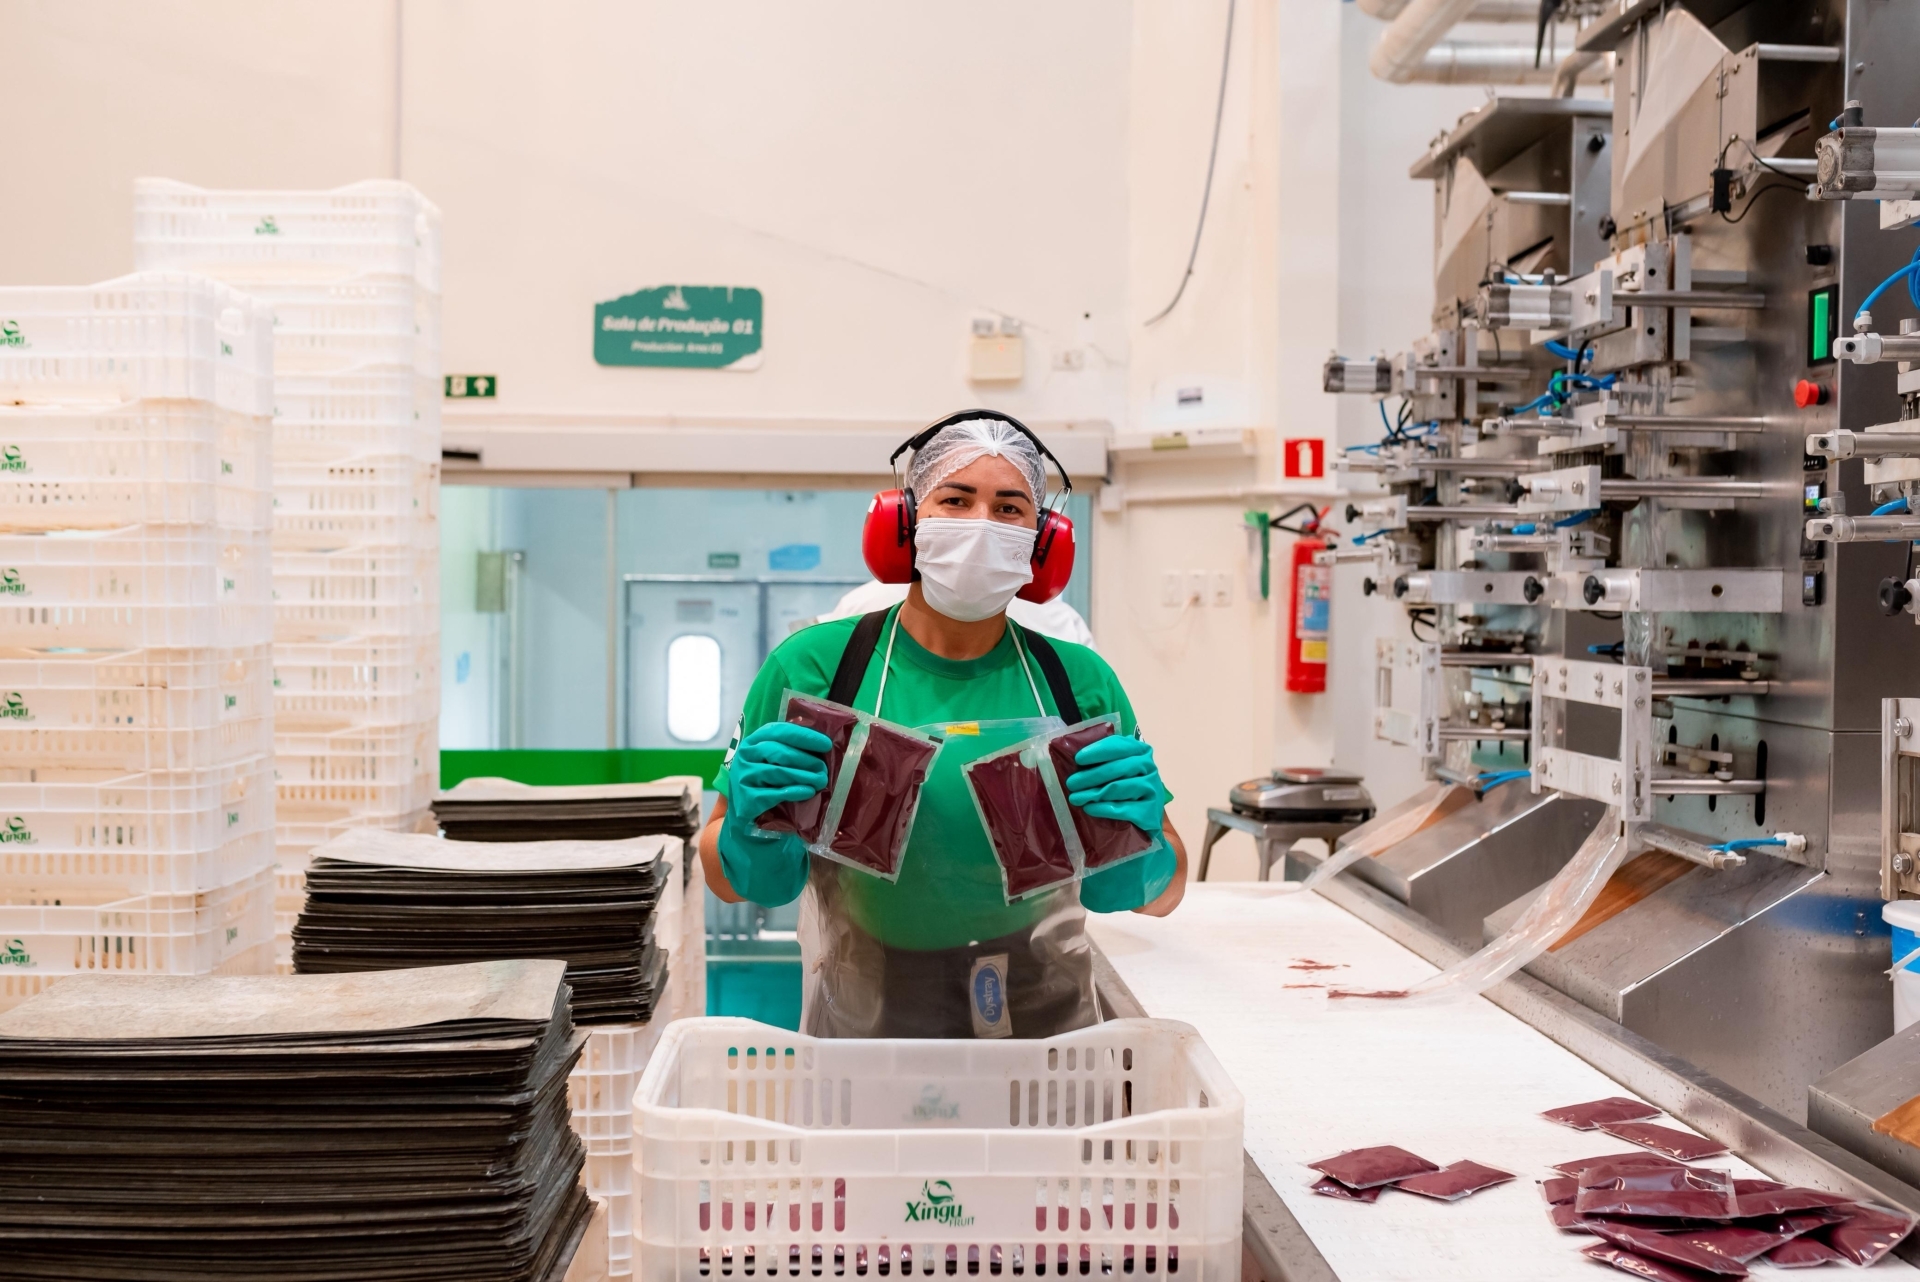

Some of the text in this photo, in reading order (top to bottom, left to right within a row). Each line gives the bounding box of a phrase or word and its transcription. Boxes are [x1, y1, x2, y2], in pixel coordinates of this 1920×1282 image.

[602, 316, 754, 336] Sala de Produção 01
[983, 976, 997, 1016] Dystray
[904, 1201, 963, 1224] Xingu
[949, 1216, 975, 1228] FRUIT
